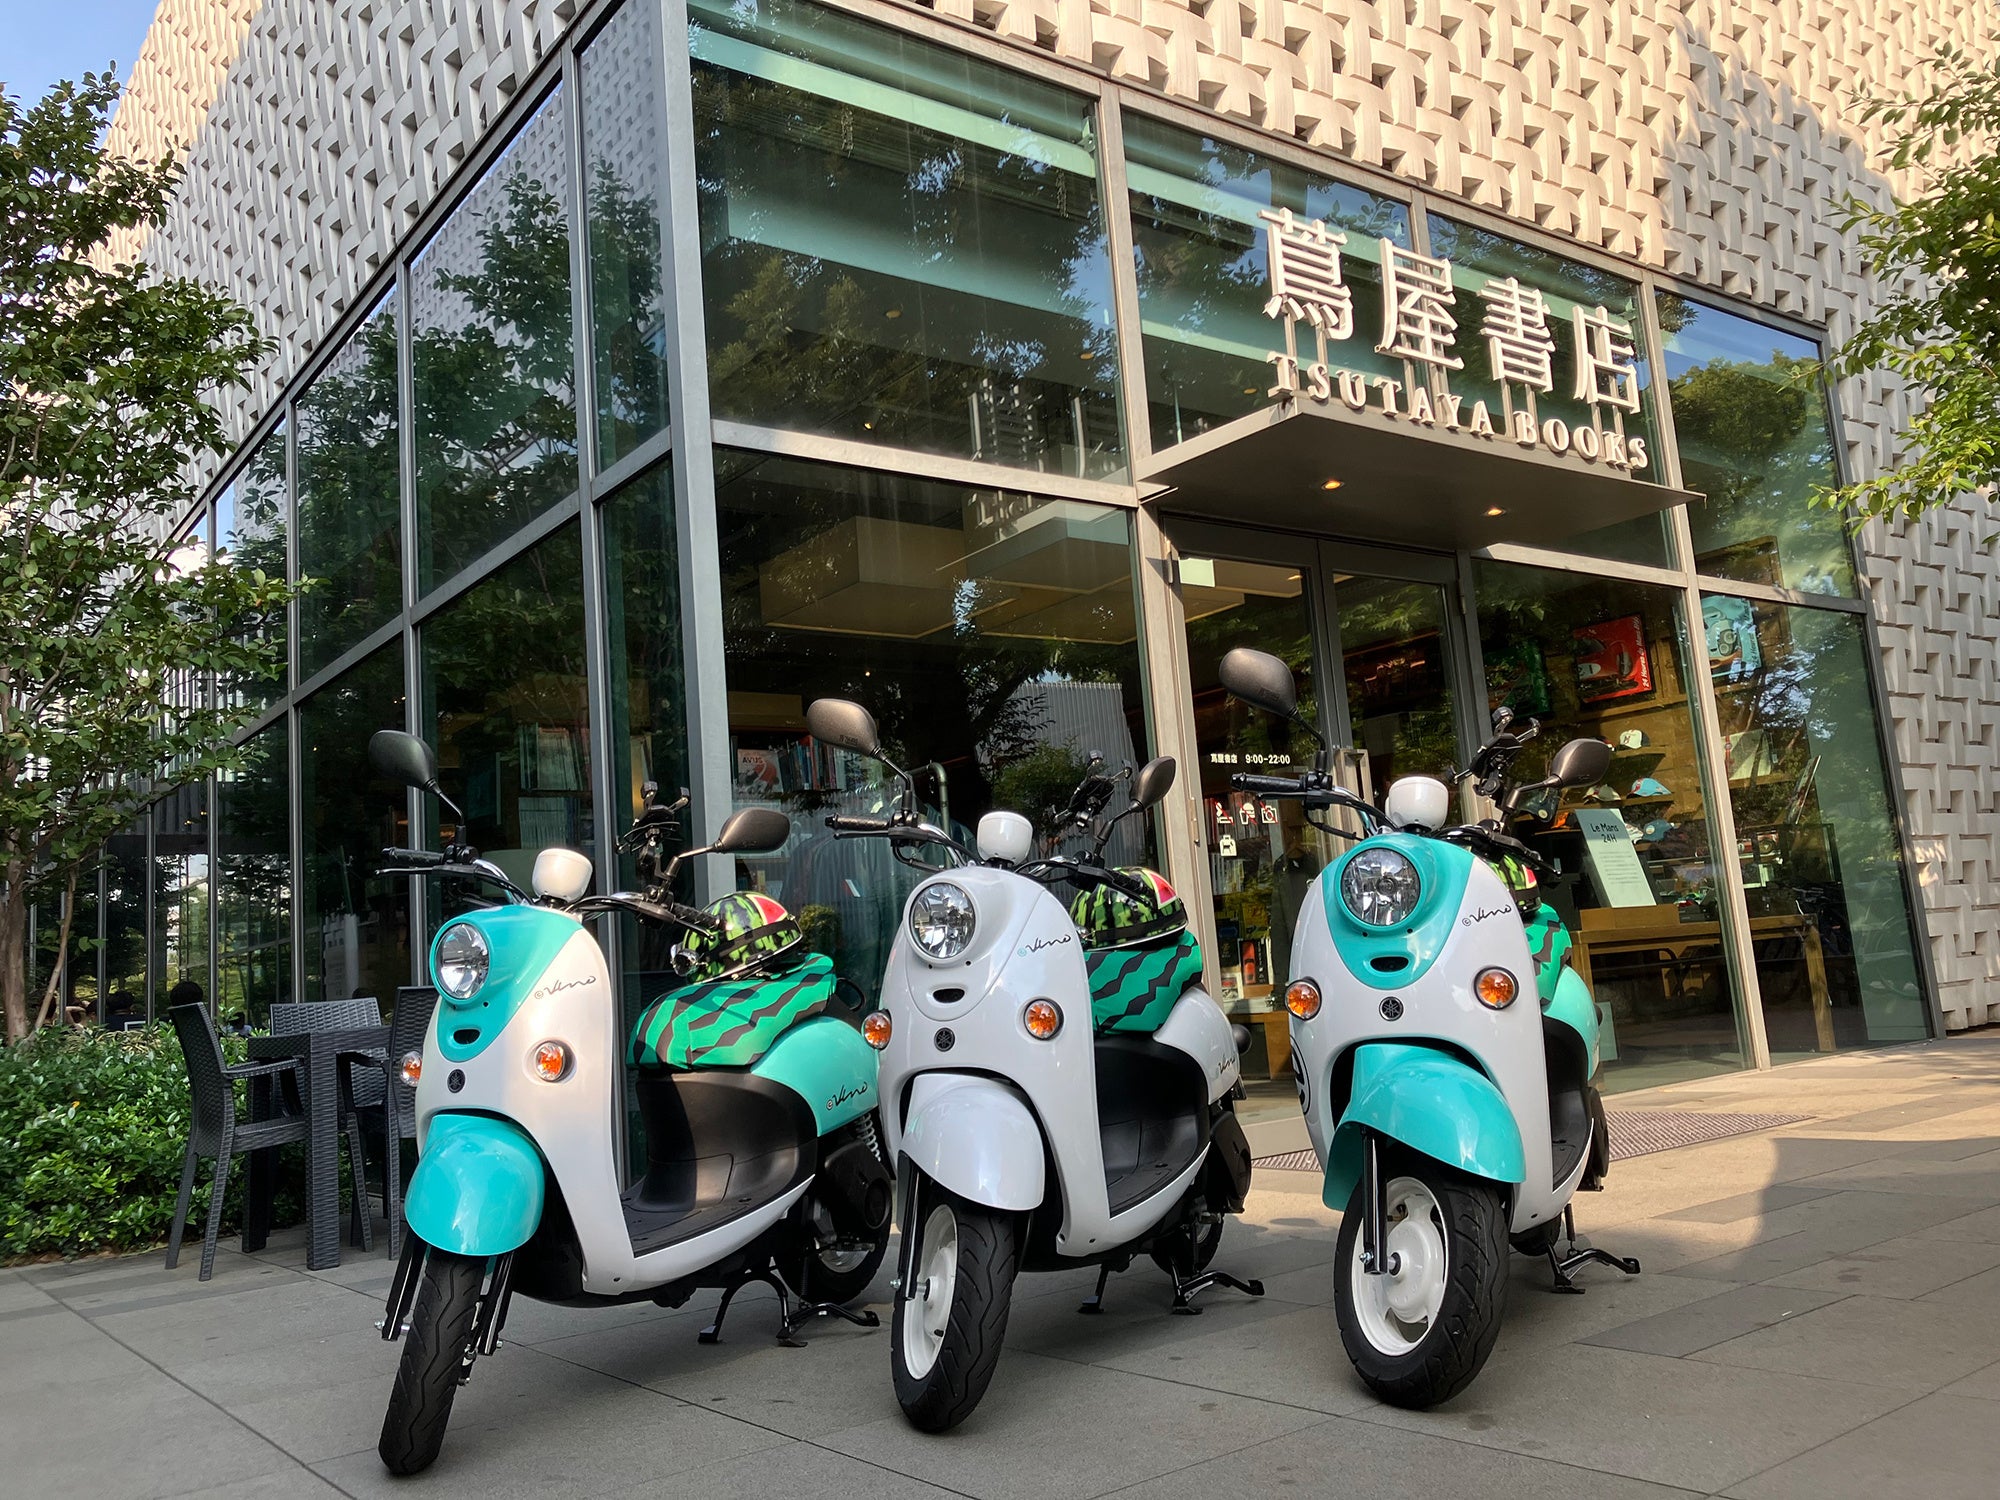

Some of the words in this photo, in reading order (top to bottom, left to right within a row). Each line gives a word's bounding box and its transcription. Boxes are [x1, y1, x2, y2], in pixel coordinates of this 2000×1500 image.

[1257, 207, 1642, 415] 蔦屋書店
[1266, 351, 1495, 438] TSUTAYA
[1513, 409, 1649, 470] BOOKS
[1590, 823, 1600, 833] Le
[1600, 823, 1619, 833] Mans
[1601, 834, 1617, 843] 24H
